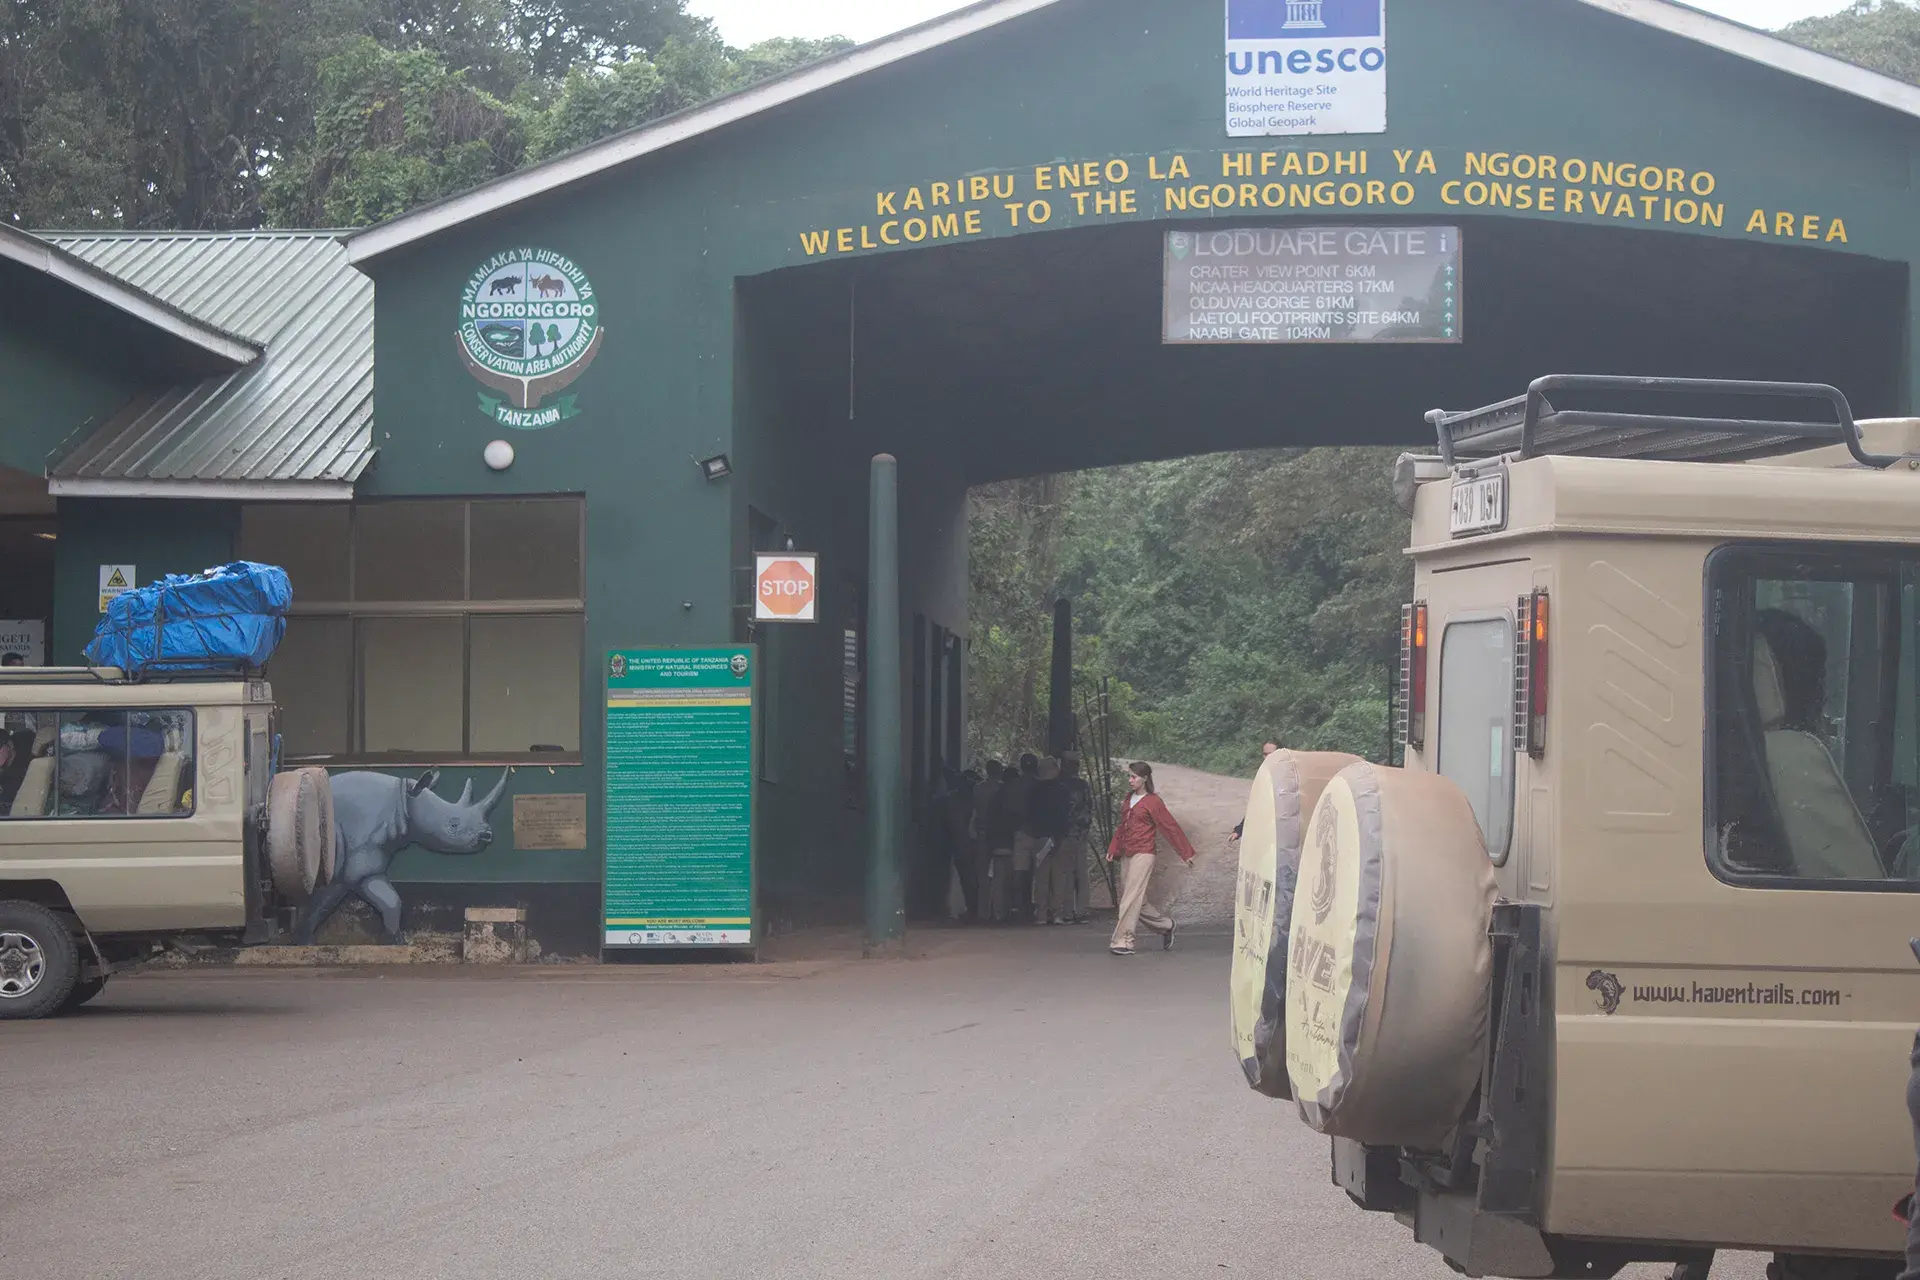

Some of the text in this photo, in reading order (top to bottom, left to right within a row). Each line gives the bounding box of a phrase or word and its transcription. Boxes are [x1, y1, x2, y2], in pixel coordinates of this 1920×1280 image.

[1228, 47, 1384, 76] unesco
[1228, 84, 1337, 98] World Heritage Site
[1228, 101, 1332, 114] Biosphere Reserve
[1228, 115, 1316, 128] Global Geopark
[876, 149, 1715, 216] KARIBU ENEO LA HIFADHI YA NGORONGORO
[799, 180, 1849, 256] WELCOME TO THE NGORONGORO CONSERVATION AREA
[1195, 231, 1426, 256] LODUARE GATE
[462, 248, 593, 302] MAMLAKA YA HIFADHI YA
[1190, 265, 1376, 278] CRATER VIEW POINT 6KM
[1190, 281, 1394, 294] NCAA HEADQUARTERS 17KM
[463, 303, 594, 318] NGORONGORO
[1189, 296, 1354, 310] OLDUVAI GORGE 61KM
[1189, 311, 1420, 325] LAETOLI FOOTPRINTS SITE 64KM
[1189, 327, 1331, 340] NAABI GATE 104KM
[462, 320, 593, 375] CONSERVATION AREA AUTHORITY
[498, 407, 560, 427] TANZANIA
[762, 579, 810, 596] STOP
[0, 633, 31, 644] GETI
[1633, 981, 1840, 1006] www.haventrails.com
